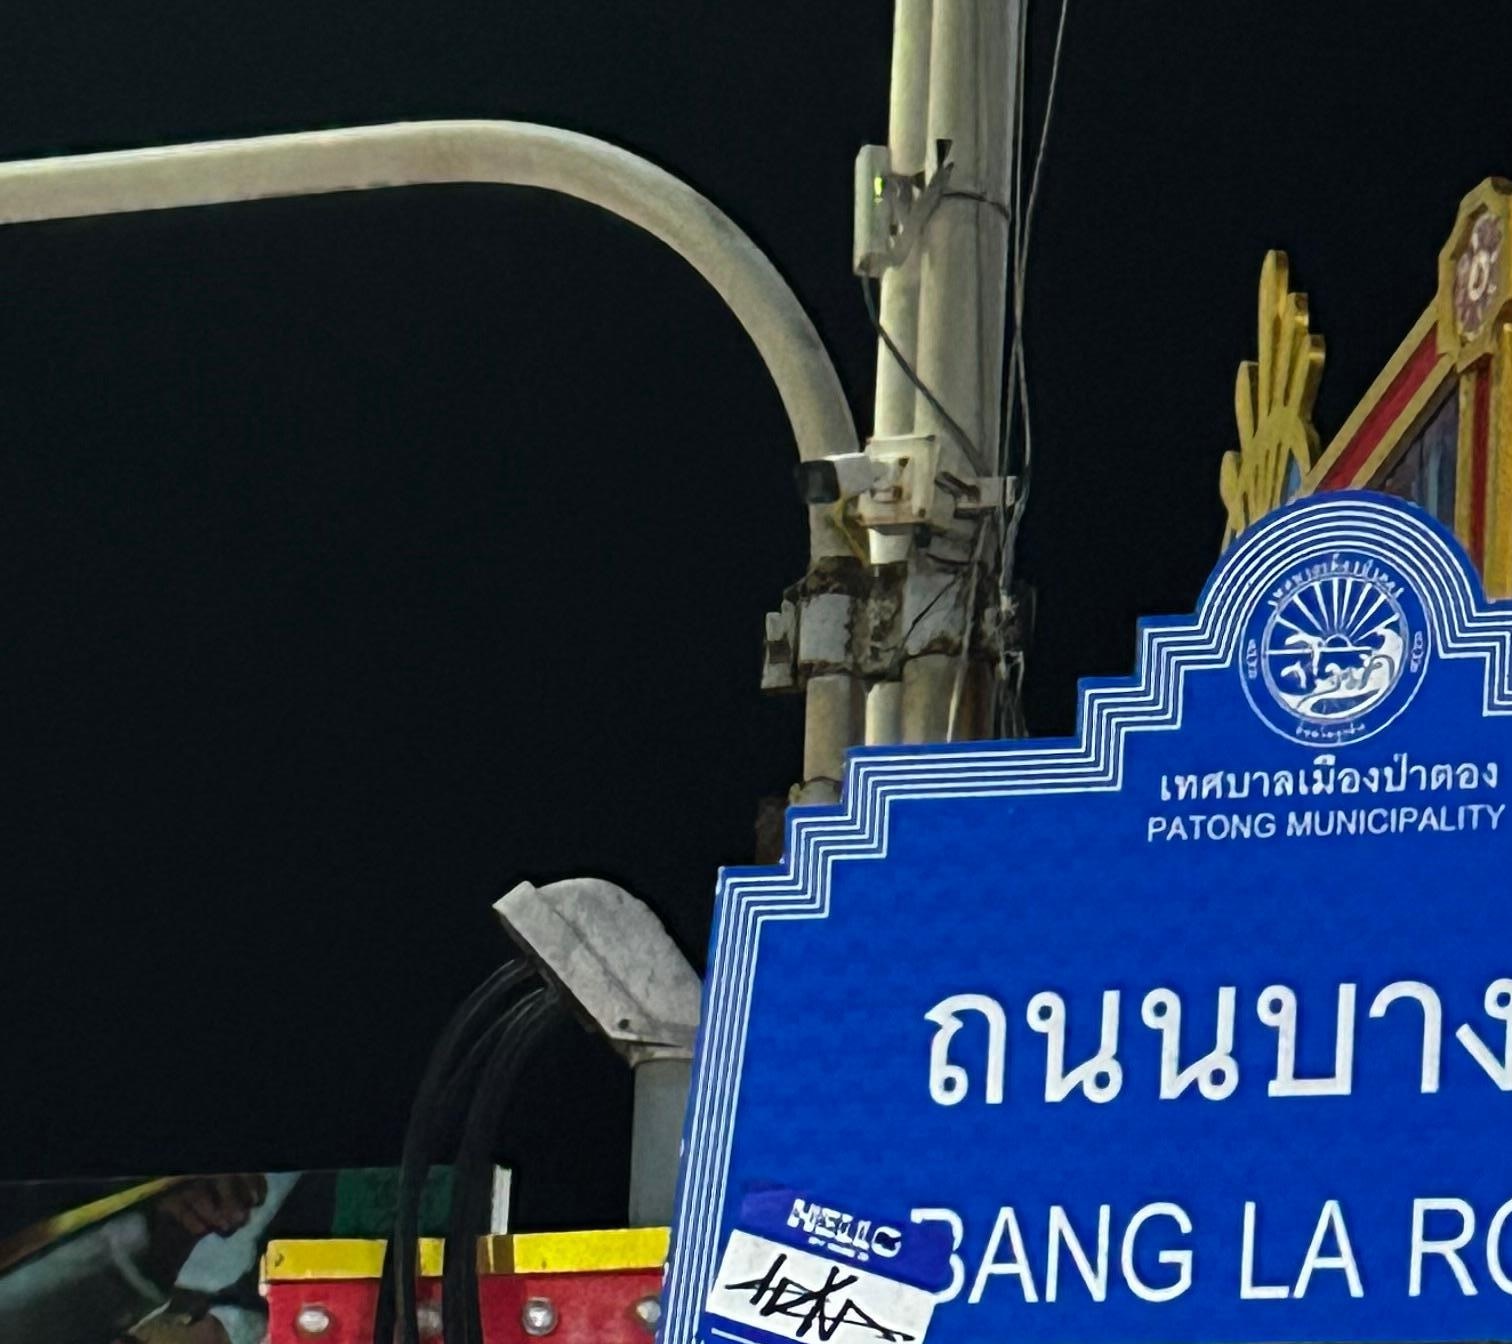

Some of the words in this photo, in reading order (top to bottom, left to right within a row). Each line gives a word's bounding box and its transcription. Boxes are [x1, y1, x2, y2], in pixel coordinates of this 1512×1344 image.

[1160, 752, 1498, 801] เทศบาลเมืองป่าตอง
[1148, 812, 1277, 842] PATONG
[1286, 803, 1505, 837] MUNICIPALITY
[786, 1197, 902, 1259] HELLO
[1240, 1199, 1364, 1300] LA
